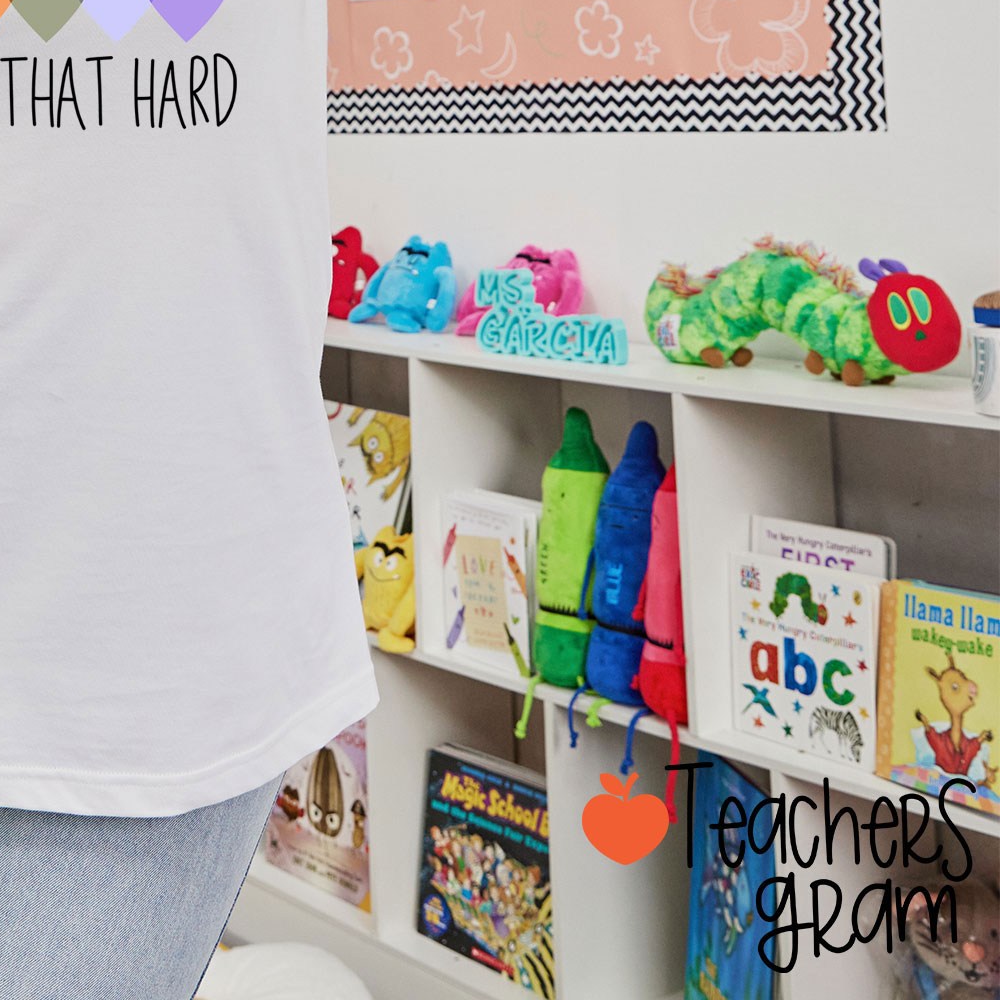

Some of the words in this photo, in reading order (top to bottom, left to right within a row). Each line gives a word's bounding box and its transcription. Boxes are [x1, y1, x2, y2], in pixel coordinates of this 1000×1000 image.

[0, 56, 113, 131] THAT
[134, 53, 238, 130] HARD
[477, 310, 628, 365] GARCIA
[904, 593, 954, 628] llama
[960, 605, 1000, 638] llam
[750, 636, 856, 706] abc
[441, 771, 487, 811] Magic
[487, 788, 541, 833] School
